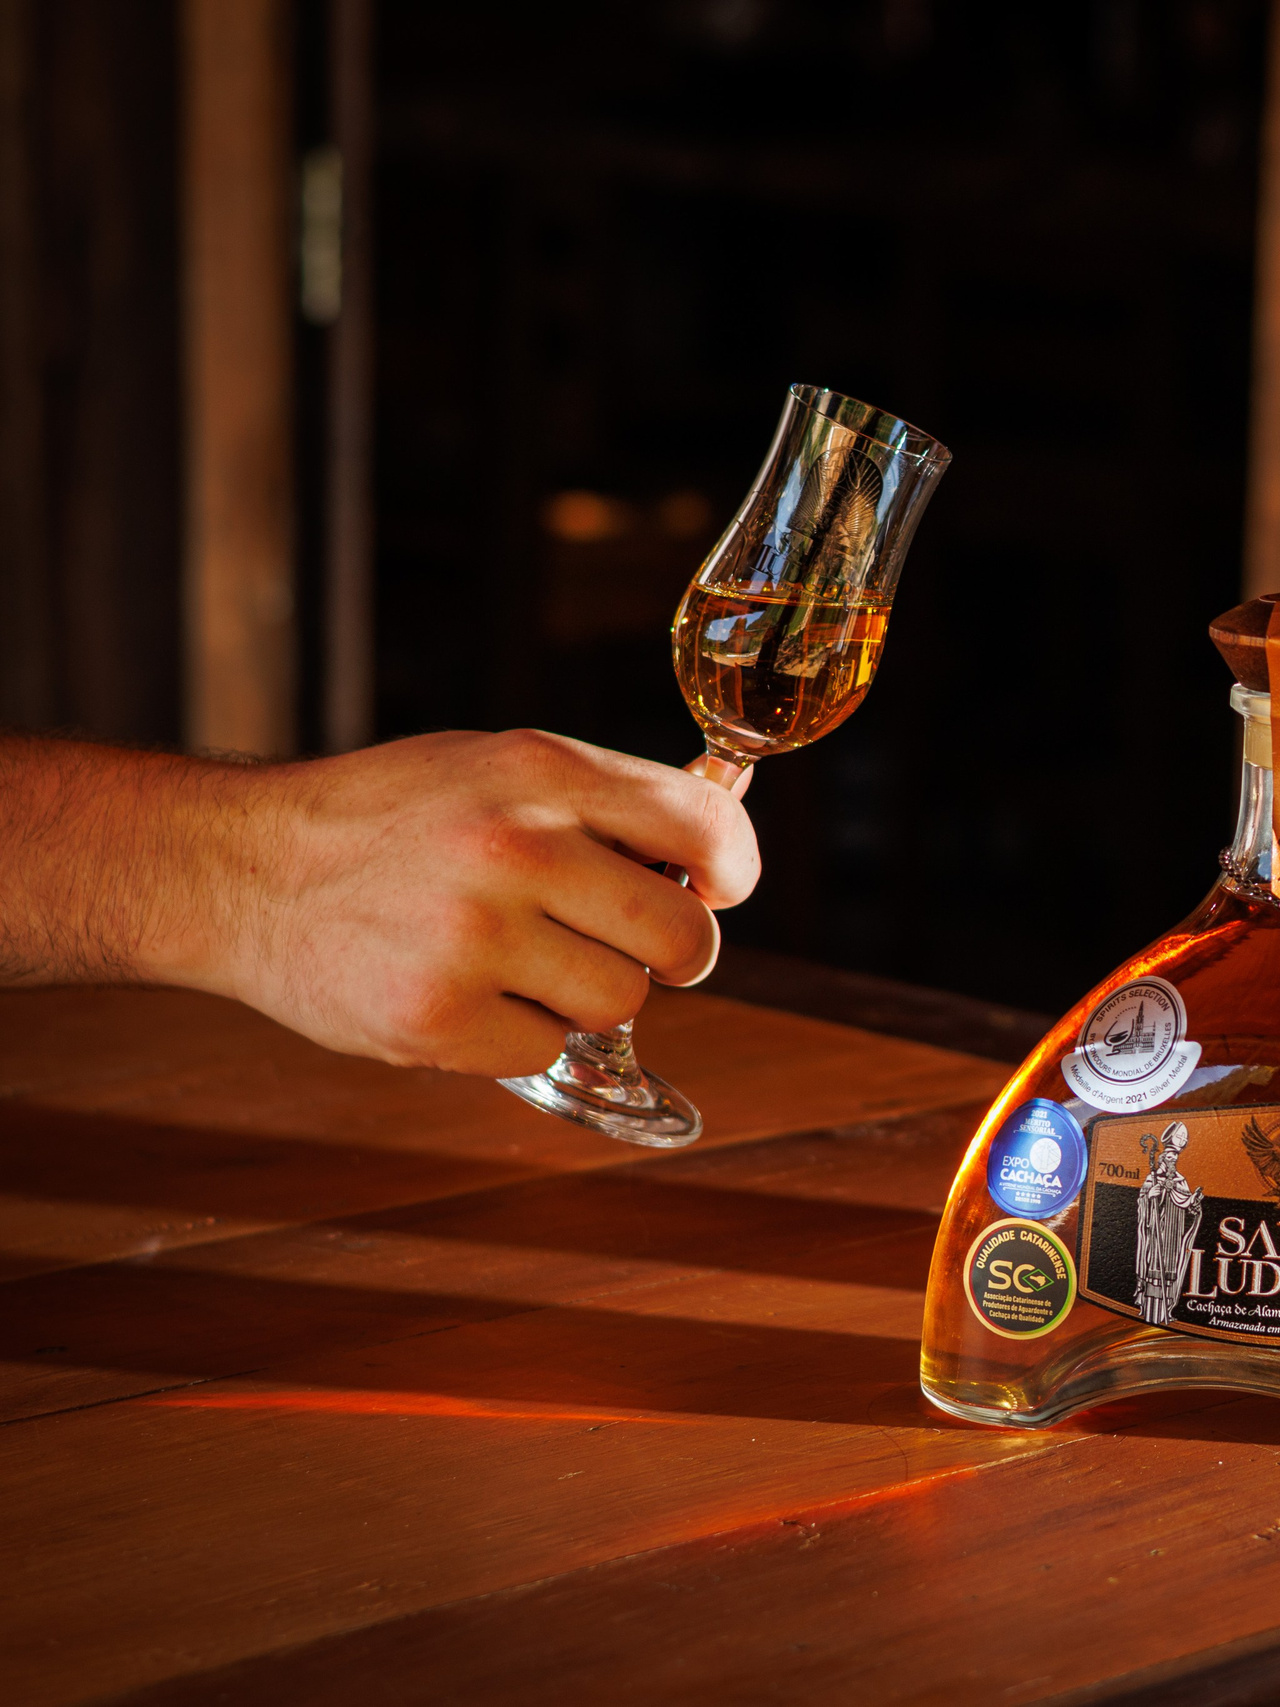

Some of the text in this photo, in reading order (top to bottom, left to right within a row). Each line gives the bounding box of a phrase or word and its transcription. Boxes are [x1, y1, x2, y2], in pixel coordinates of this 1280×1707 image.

[1096, 989, 1171, 1022] SPIRITS SELECTION
[1089, 1044, 1115, 1074] CONCOURS
[1112, 1067, 1144, 1077] MONDIAL
[1144, 1061, 1154, 1071] DE
[1153, 1022, 1172, 1063] BRUXELLES
[1070, 1054, 1188, 1104] Médaille d'Argent 2021 Silver Medal
[1020, 1124, 1056, 1135] SENSORIAL
[1002, 1155, 1030, 1169] EXPO
[1000, 1168, 1062, 1188] CACHAÇA
[976, 1230, 1067, 1280] QUALIDADE CATARINENSE
[982, 1300, 1011, 1311] Produtores
[1011, 1304, 1018, 1312] de
[1018, 1305, 1049, 1316] Aguardente
[983, 1292, 1052, 1307] Associação Catarinense de
[1186, 1299, 1232, 1316] Cachaça
[1234, 1304, 1247, 1316] de
[989, 1309, 1045, 1324] Cachaça de Qualidade
[1208, 1316, 1266, 1333] Armazenada
[1267, 1325, 1280, 1334] em
